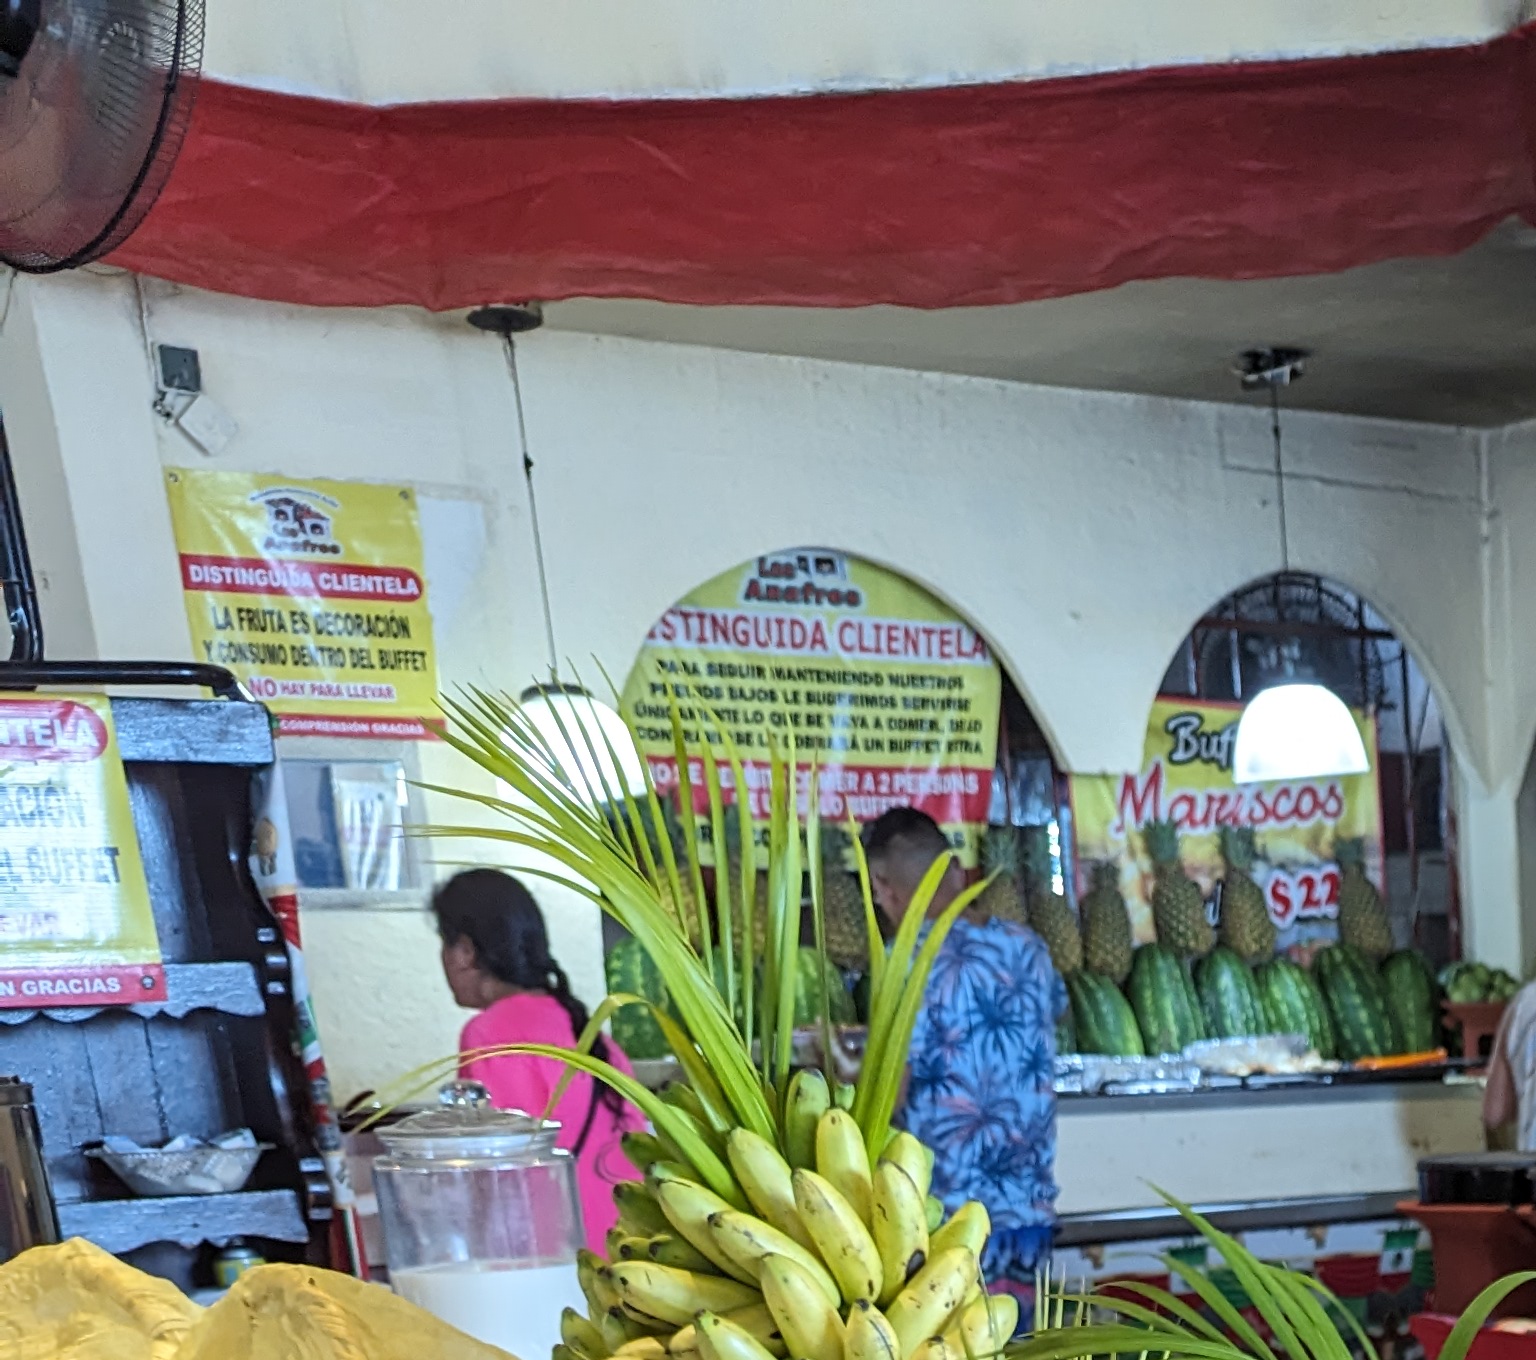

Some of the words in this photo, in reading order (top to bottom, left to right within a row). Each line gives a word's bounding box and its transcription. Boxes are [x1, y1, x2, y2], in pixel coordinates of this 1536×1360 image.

[188, 564, 314, 589] DISTINGUIDA
[319, 572, 420, 596] CLIENTELA
[212, 606, 234, 632] LA
[237, 606, 289, 634] FRUTA
[289, 610, 312, 635] ES
[314, 610, 412, 640] DECORACIÓN
[648, 607, 829, 652] STINGUIDA
[839, 619, 988, 662] CLIENTELA
[202, 639, 214, 663] Y
[217, 640, 288, 667] CONSUMO
[291, 645, 347, 669] DENTRO
[349, 646, 376, 670] DEL
[378, 648, 428, 672] BUFFET
[251, 677, 277, 698] NO
[280, 681, 306, 697] HAY
[309, 682, 345, 698] PARA
[346, 683, 395, 700] LLEVAR
[1166, 711, 1242, 771] Buf
[1113, 760, 1344, 834] Mariscos
[1269, 870, 1341, 919] $22
[21, 976, 122, 996] GRACIAS
